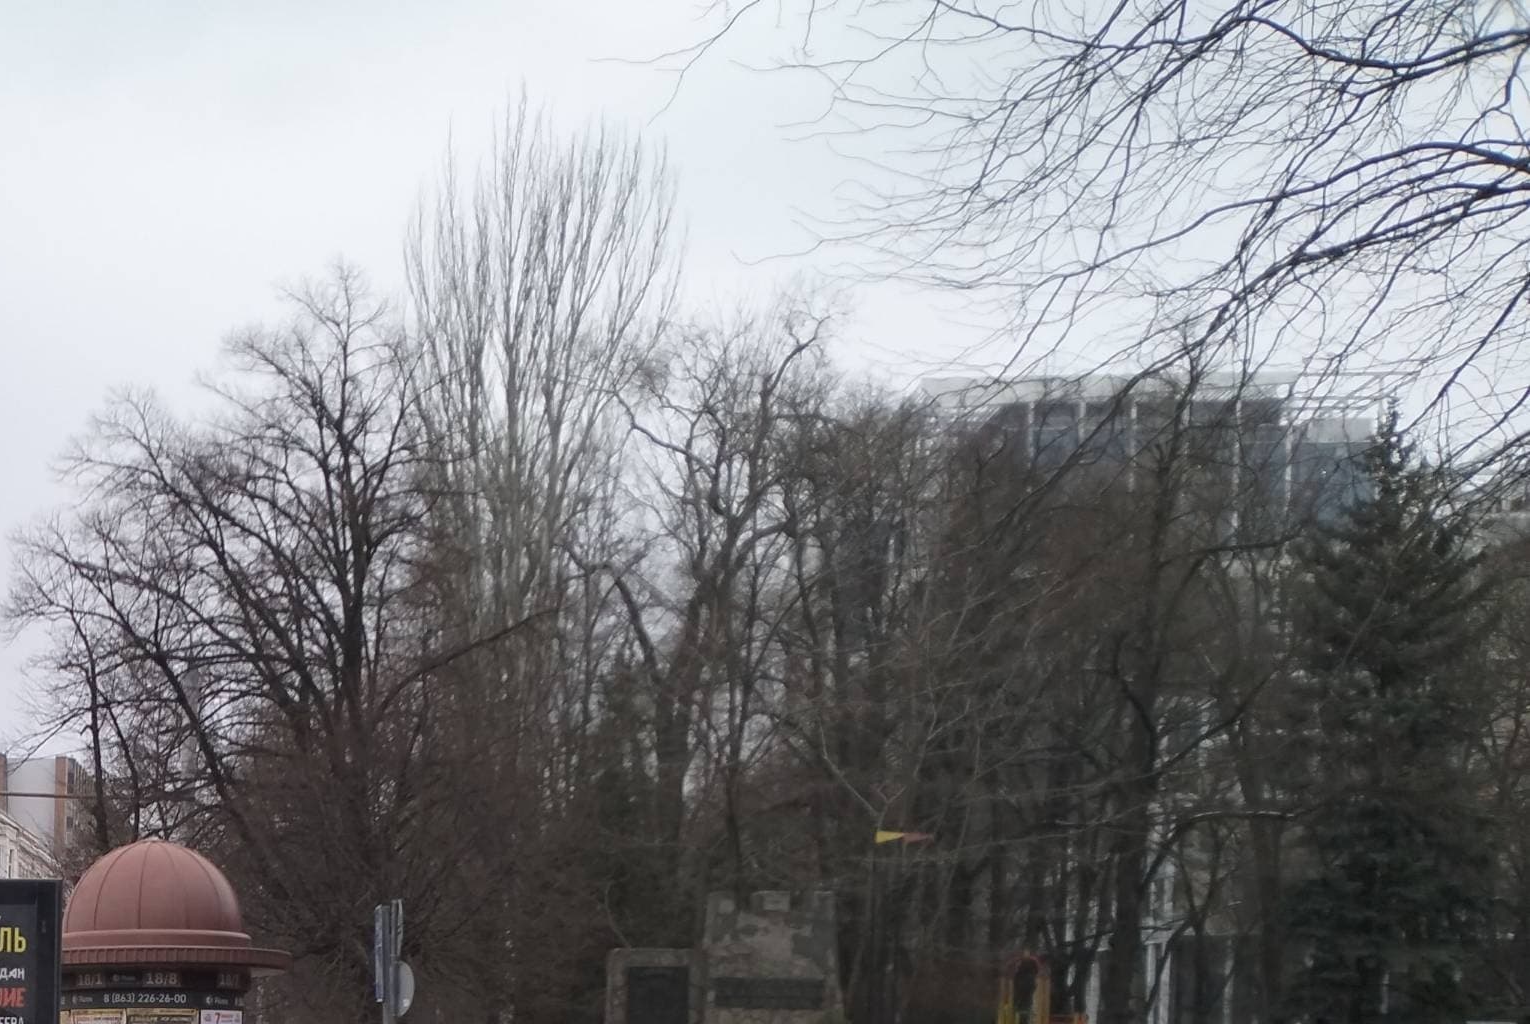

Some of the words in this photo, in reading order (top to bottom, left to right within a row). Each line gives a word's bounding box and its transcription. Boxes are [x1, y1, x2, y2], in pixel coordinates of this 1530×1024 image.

[103, 994, 111, 1003] 8
[112, 993, 135, 1004] (863)
[138, 993, 187, 1004] 226-26-00
